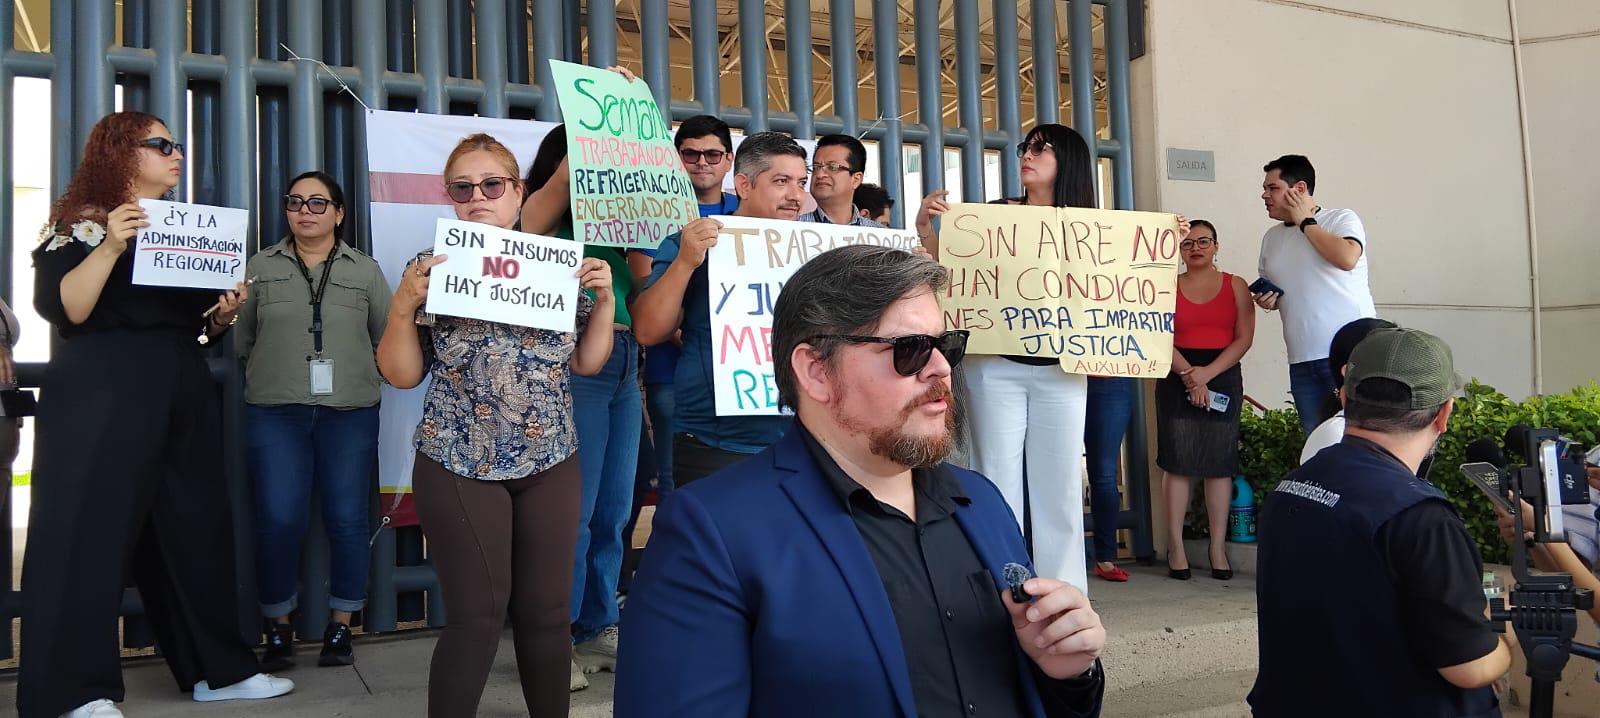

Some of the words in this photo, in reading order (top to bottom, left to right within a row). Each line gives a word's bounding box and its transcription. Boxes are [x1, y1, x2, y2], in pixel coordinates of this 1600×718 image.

[574, 78, 672, 141] Seman
[576, 136, 674, 168] TRABAJANDO
[1176, 160, 1207, 170] SALIDA
[575, 168, 688, 198] REFRIGERACIÓN
[164, 206, 188, 226] ¿Y
[197, 214, 217, 228] LA
[576, 197, 681, 221] ENCERRADOS
[141, 232, 242, 253] ADMINISTRACIÓN
[584, 219, 661, 244] EXTREMO
[946, 214, 1016, 258] SIN
[1038, 221, 1116, 267] AIRE
[1132, 225, 1178, 262] NO
[445, 228, 485, 249] SIN
[500, 238, 578, 268] INSUMOS
[154, 252, 241, 278] REGIONAL?
[481, 256, 520, 279] NO
[445, 274, 482, 298] HAY
[490, 283, 565, 311] JUSTICIA
[716, 282, 736, 315] Y
[946, 265, 1000, 299] HAY
[1016, 268, 1171, 306] CONDICIO-
[943, 308, 994, 330] NES
[1000, 306, 1073, 331] PARA
[1084, 309, 1175, 333] IMPARTIR
[1073, 360, 1140, 376] AUXILIO
